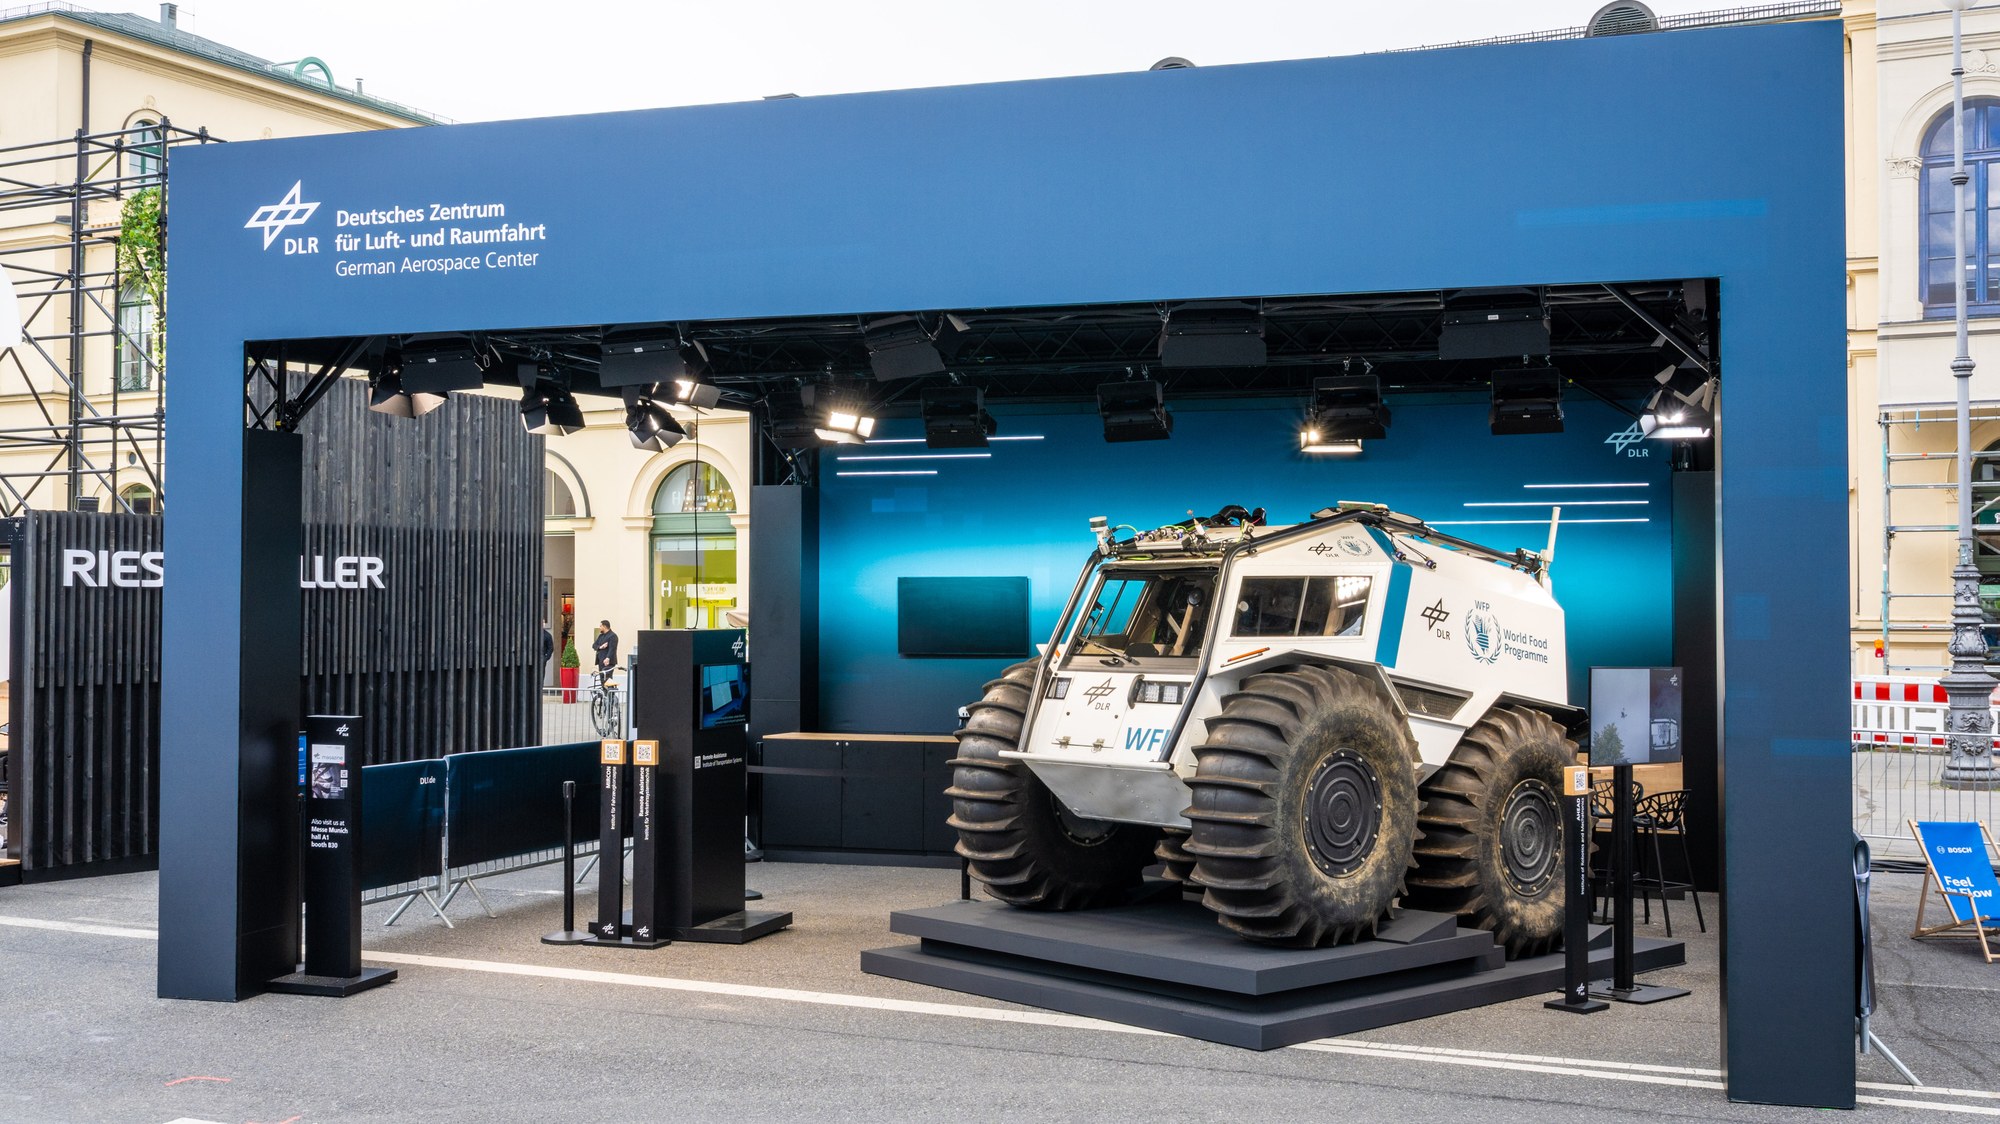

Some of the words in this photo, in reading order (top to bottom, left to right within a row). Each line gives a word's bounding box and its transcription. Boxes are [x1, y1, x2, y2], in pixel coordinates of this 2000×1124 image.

[336, 206, 425, 227] Deutsches
[429, 201, 505, 222] Zentrum
[284, 237, 319, 255] DLR
[335, 233, 361, 252] für
[365, 231, 406, 251] Luft-
[410, 228, 445, 248] und
[450, 223, 546, 245] Raumfahrt
[335, 259, 396, 277] German
[400, 254, 480, 275] Aerospace
[485, 251, 539, 269] Center
[1628, 449, 1649, 458] DLR
[1475, 600, 1490, 612] WFP
[1436, 628, 1451, 640] DLR
[1503, 629, 1527, 644] World
[1529, 635, 1548, 650] Food
[1504, 643, 1548, 664] Programme
[1095, 702, 1111, 711] DLR
[1944, 875, 1974, 887] Feel
